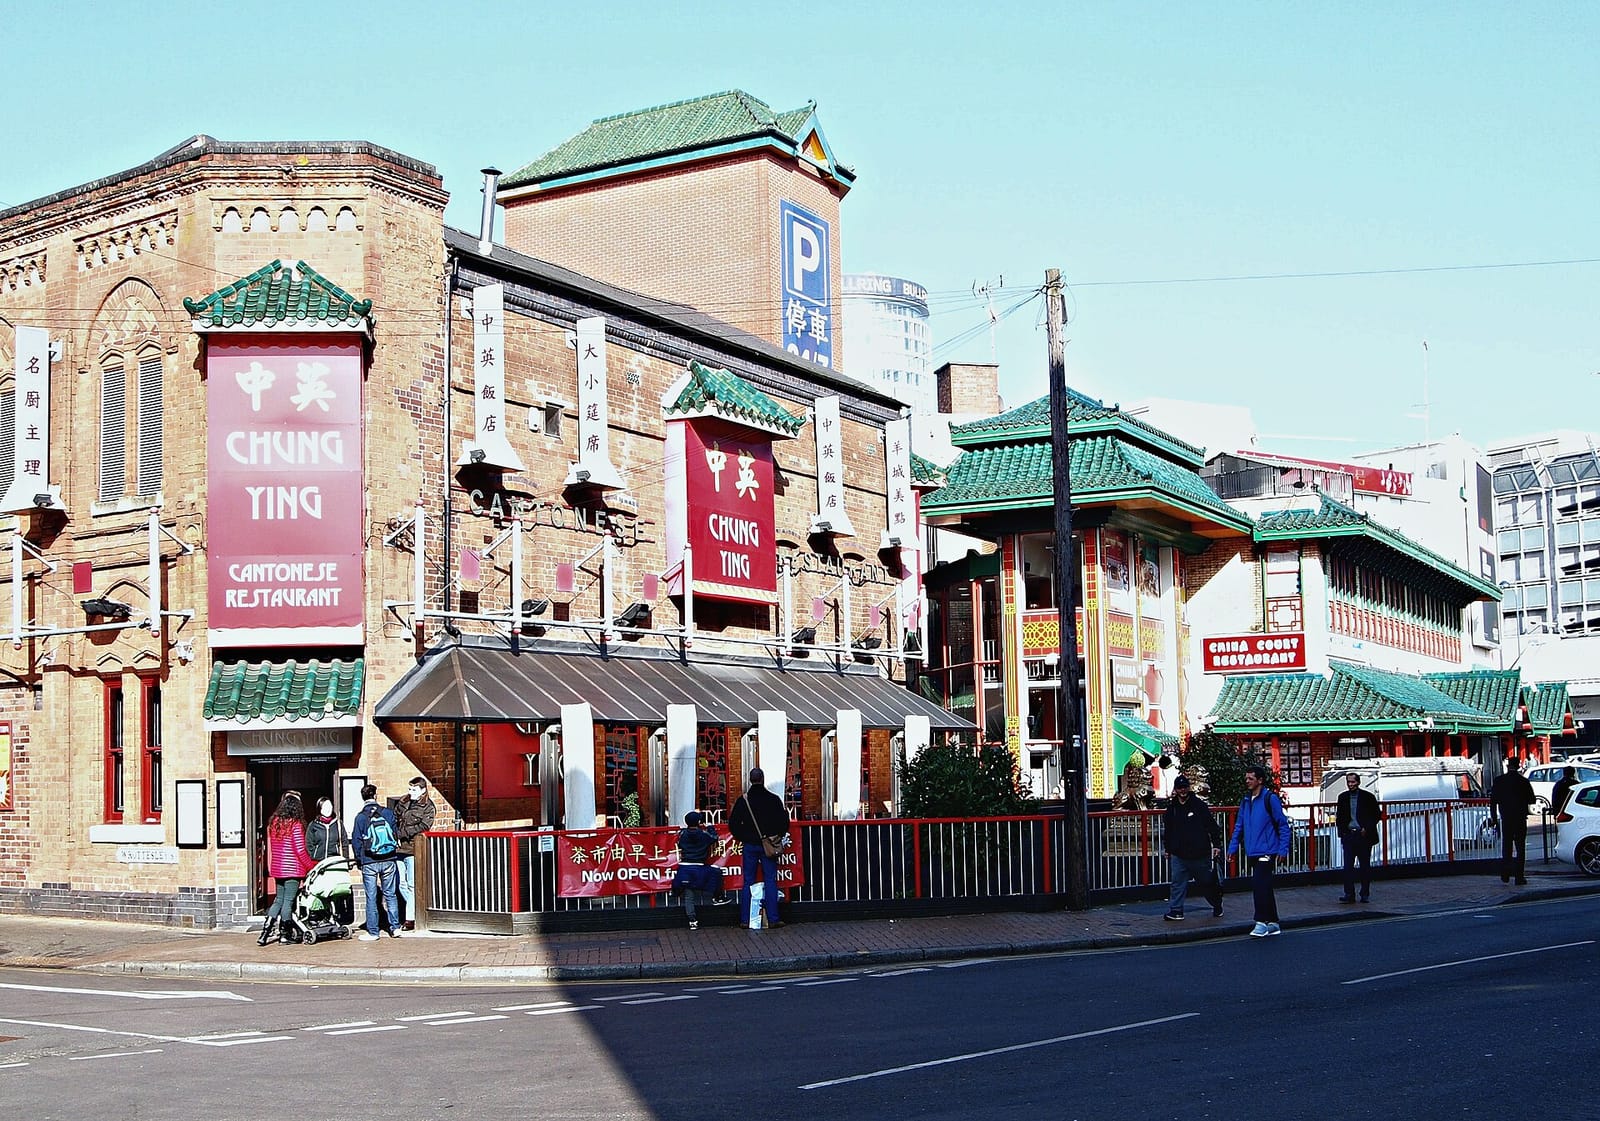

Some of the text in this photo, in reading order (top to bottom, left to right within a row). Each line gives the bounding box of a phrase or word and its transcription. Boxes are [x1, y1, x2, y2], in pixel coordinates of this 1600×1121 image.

[793, 220, 820, 292] P
[785, 297, 829, 346] 停車
[235, 361, 337, 412] 中英
[480, 313, 497, 432] 中英飯店
[584, 343, 600, 453] 大小筵席
[226, 431, 343, 465] CHUNG
[822, 418, 837, 508] 中英飯店
[706, 441, 760, 502] 中英
[245, 486, 322, 520] YING
[709, 513, 760, 548] CHUNG
[229, 563, 338, 583] CANTONESE
[720, 550, 751, 580] YING
[226, 588, 342, 608] RESTAURANT
[1209, 638, 1299, 653] CHINA COURT
[1212, 652, 1296, 666] RESTAURANT
[242, 728, 341, 748] CHUNG YING
[581, 870, 614, 883] Now
[618, 866, 661, 882] OPEN
